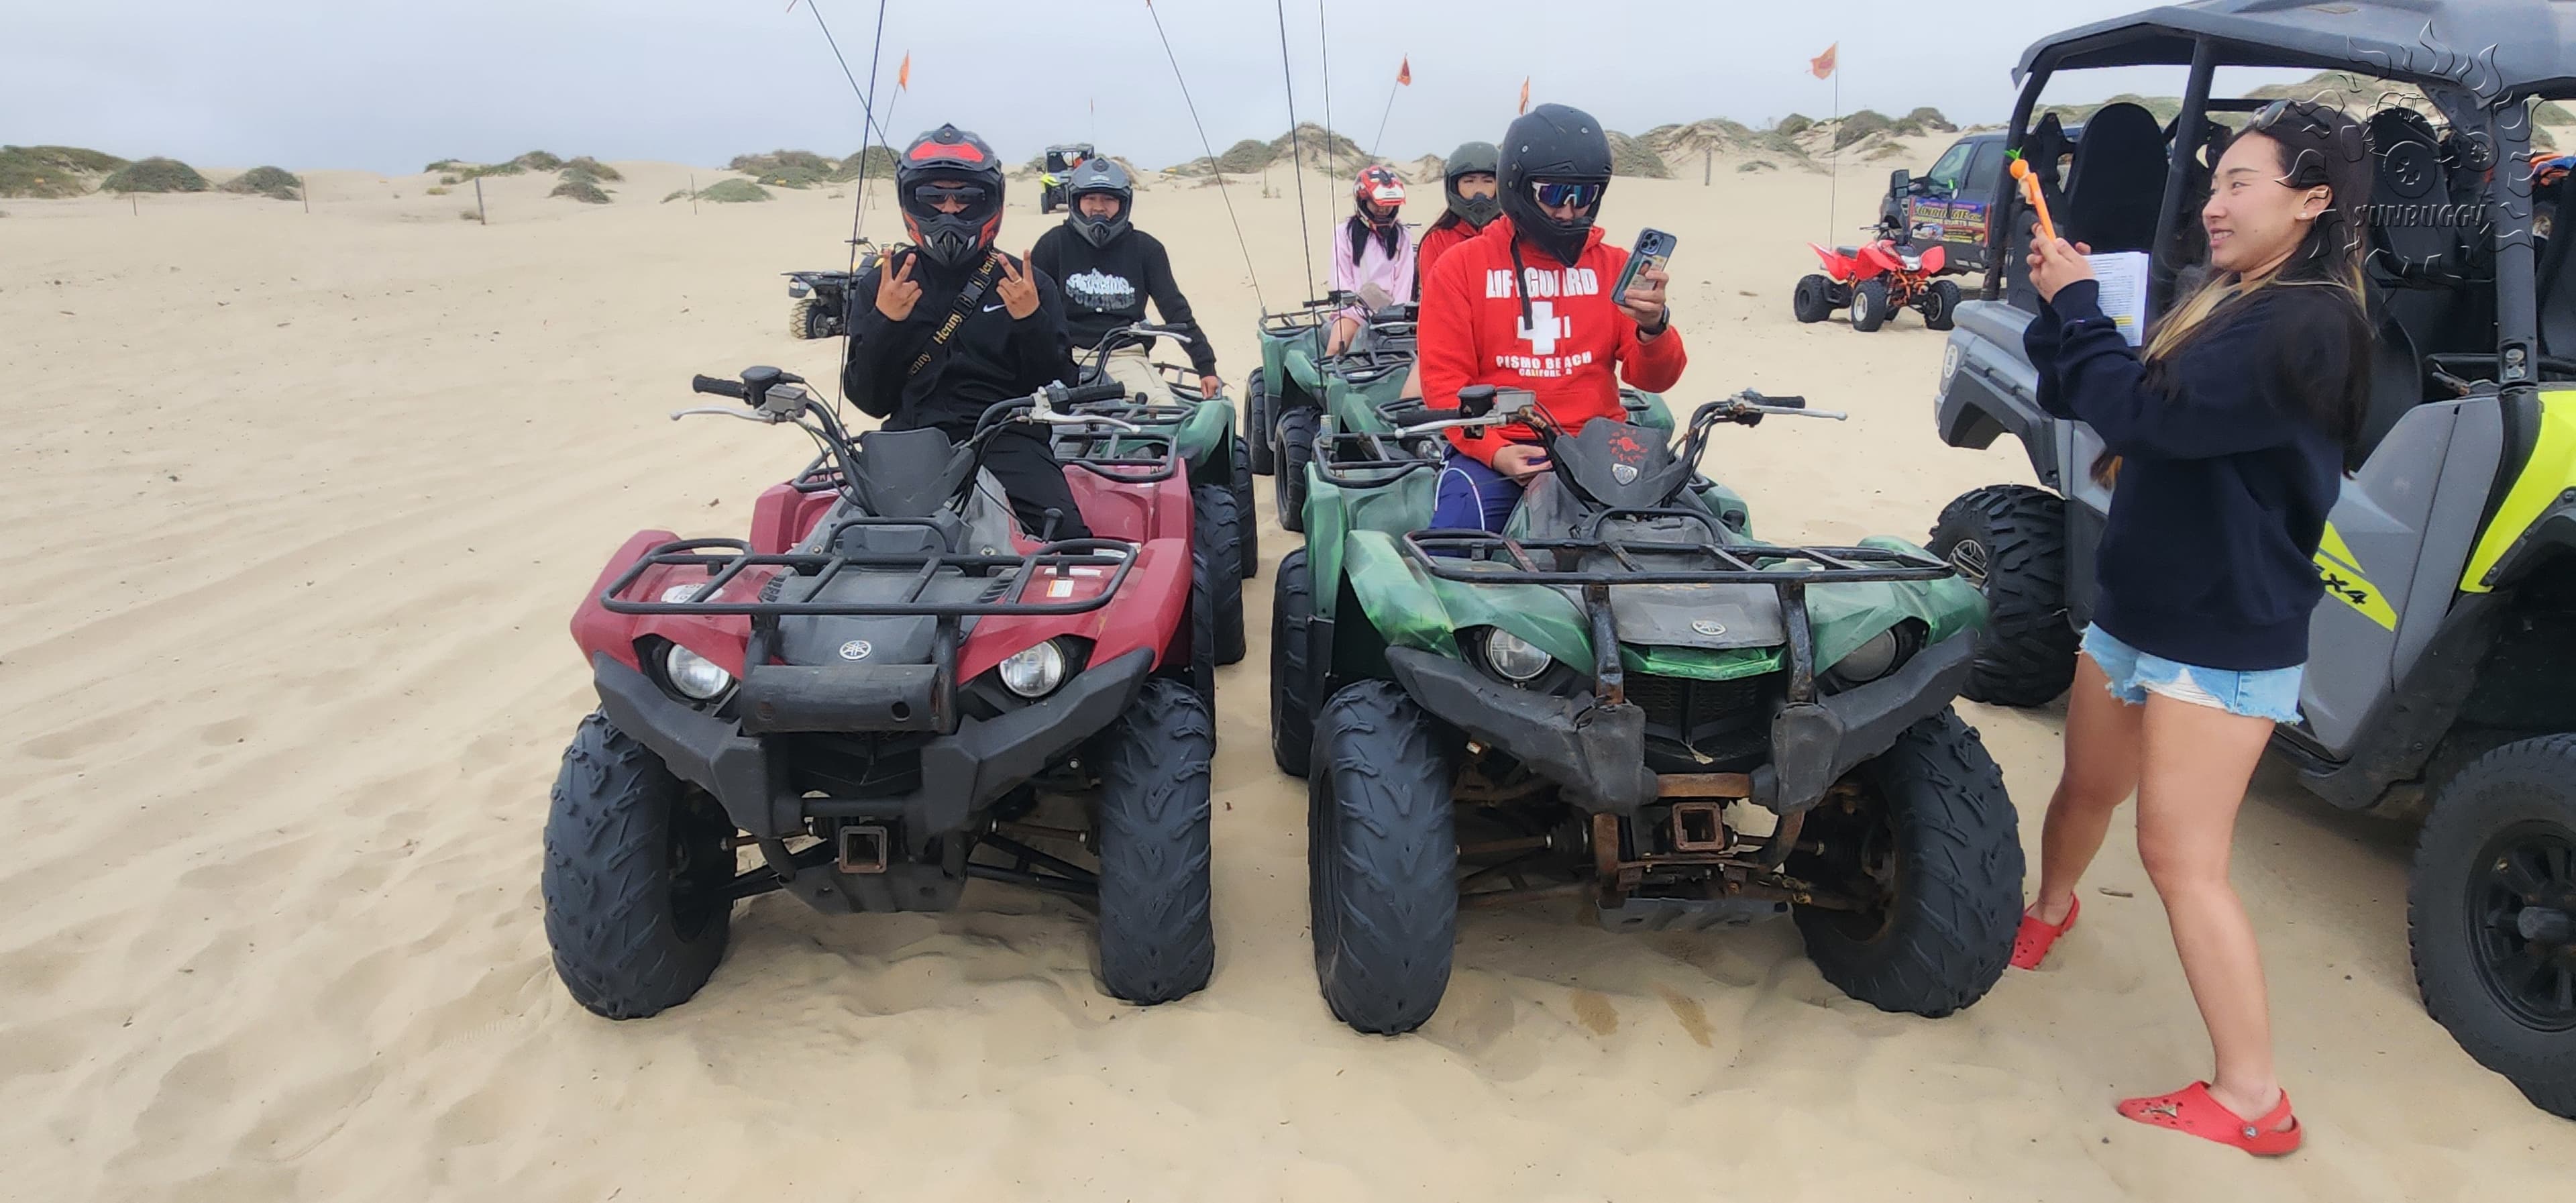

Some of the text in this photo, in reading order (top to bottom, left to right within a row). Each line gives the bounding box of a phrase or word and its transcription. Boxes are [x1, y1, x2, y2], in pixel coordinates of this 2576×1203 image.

[1486, 267, 1599, 299] LIFGUARD
[932, 313, 963, 344] Henny
[909, 351, 931, 376] enny
[1496, 350, 1592, 369] PISMO BEACH
[1518, 368, 1572, 377] CALIFORA
